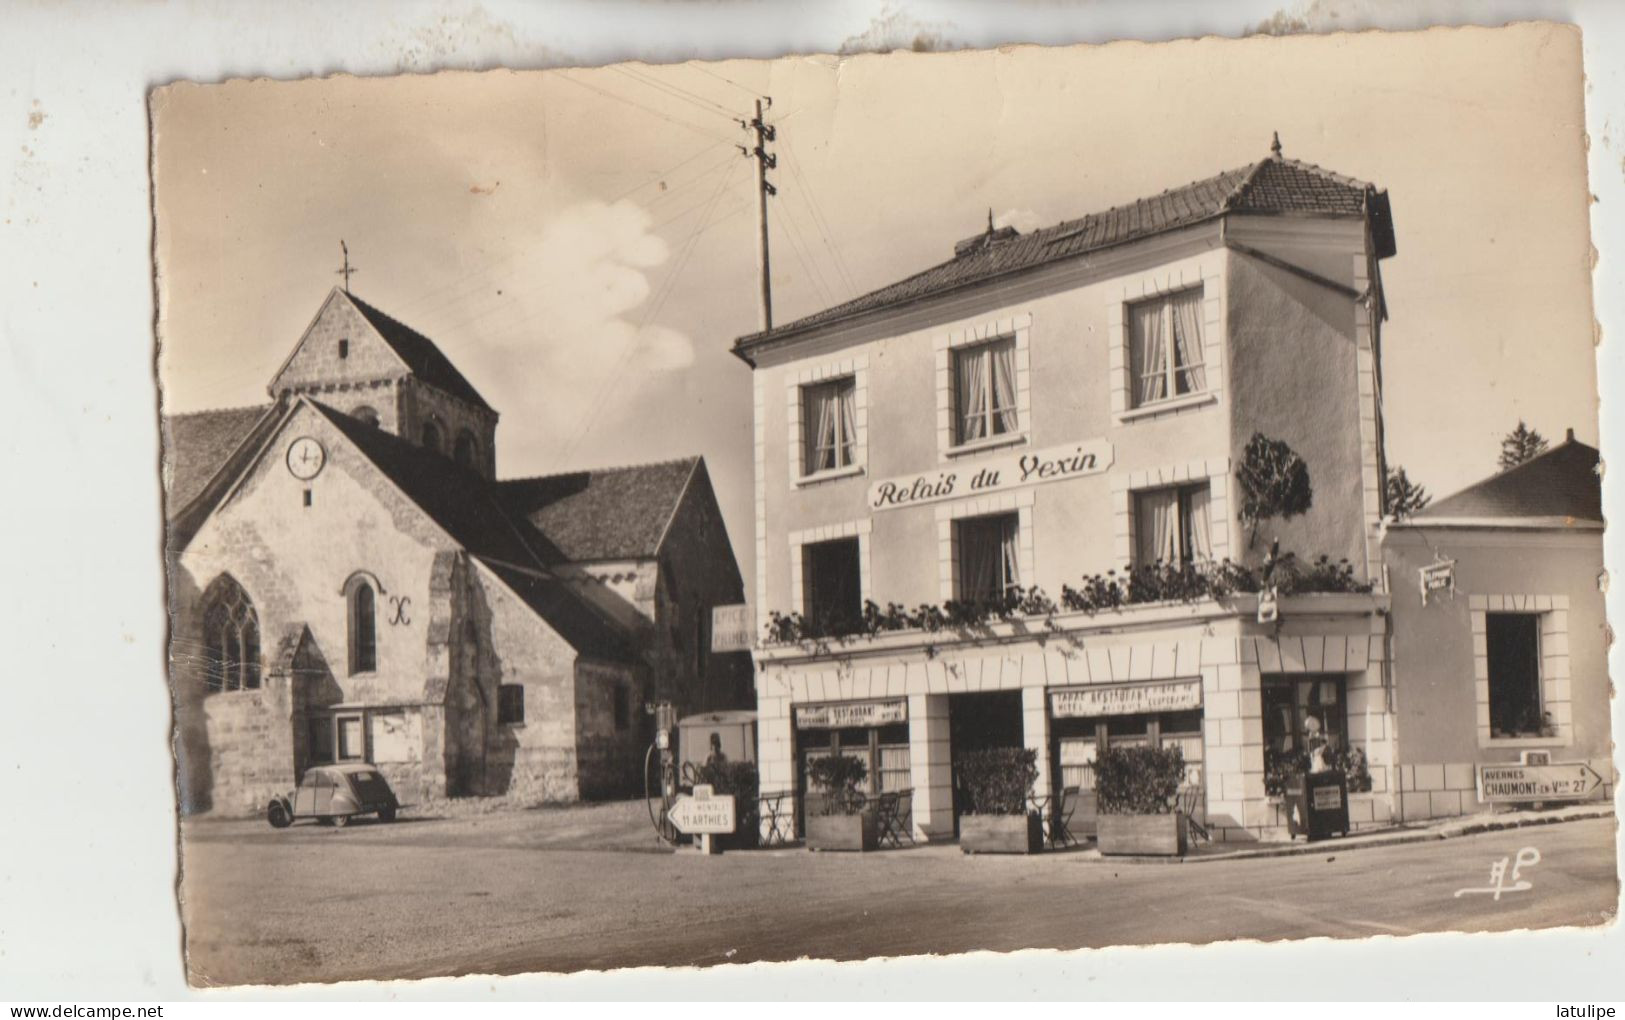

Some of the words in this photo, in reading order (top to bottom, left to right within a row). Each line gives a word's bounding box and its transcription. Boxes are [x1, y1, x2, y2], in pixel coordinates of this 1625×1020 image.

[874, 473, 956, 508] Relais
[970, 468, 1001, 491] du
[1019, 447, 1097, 482] Vexin
[1485, 770, 1525, 780] AVERNES
[1572, 780, 1587, 793] 27
[692, 814, 729, 826] ARTHIES
